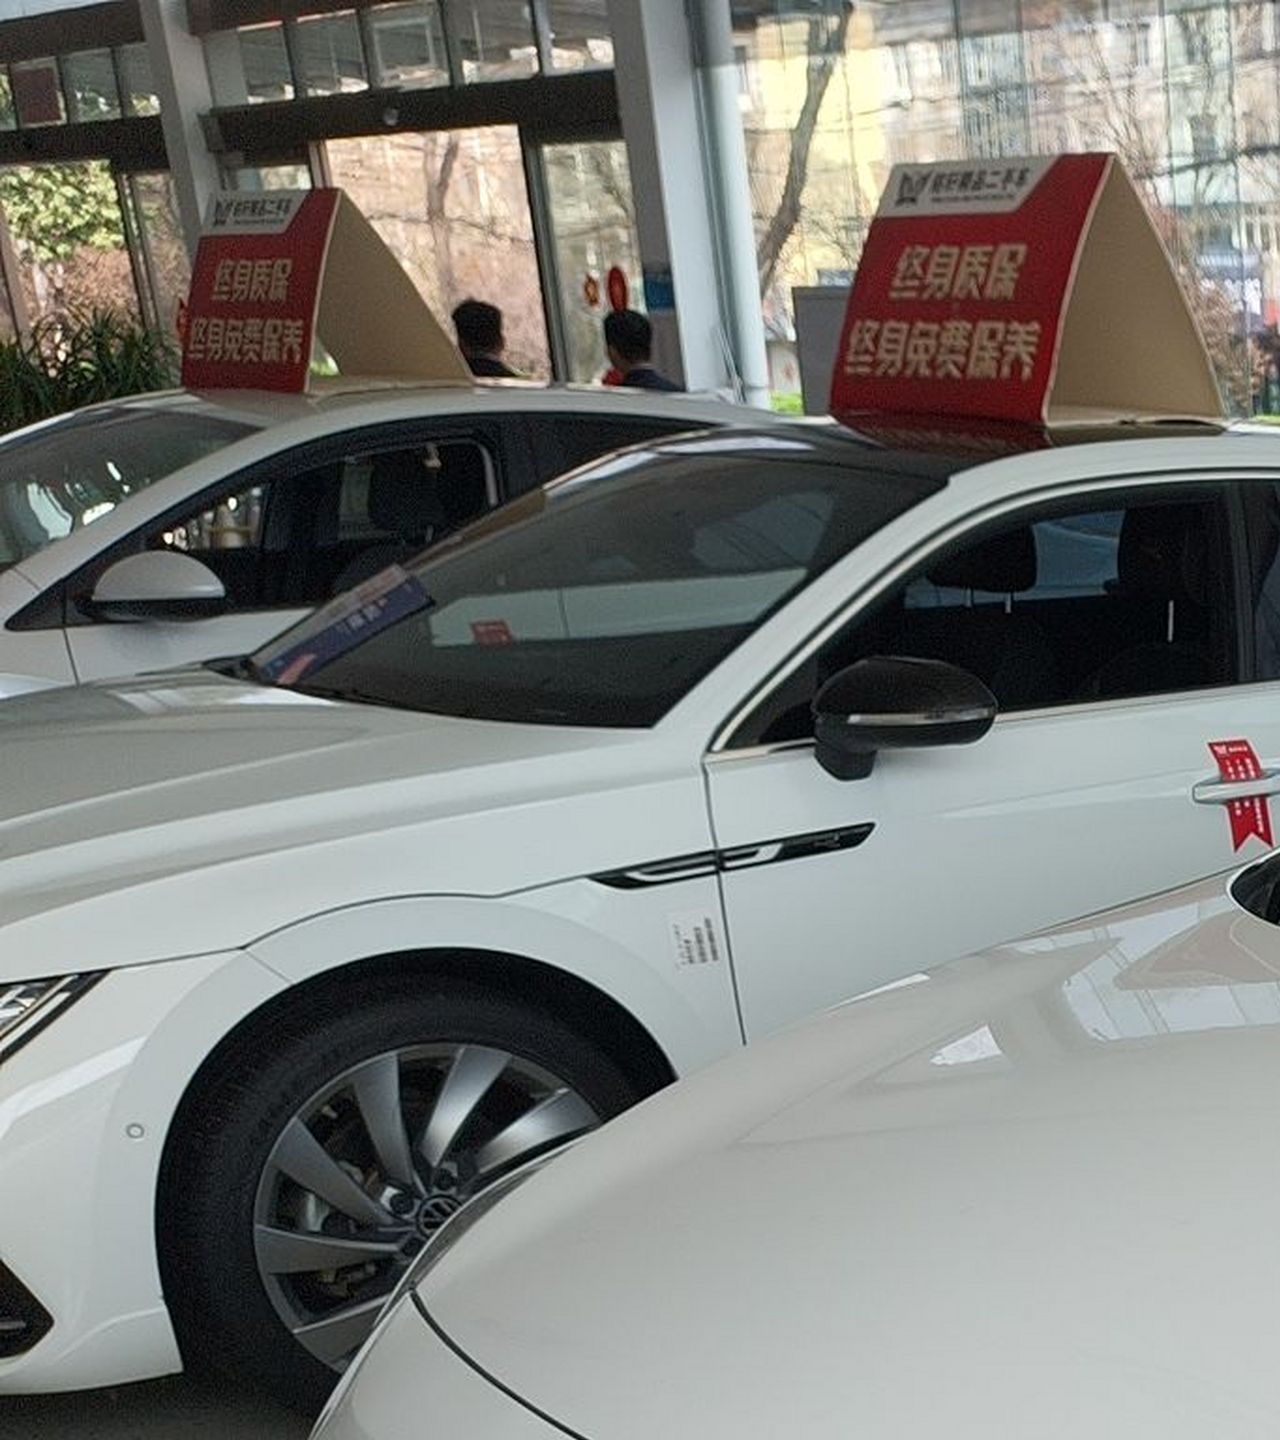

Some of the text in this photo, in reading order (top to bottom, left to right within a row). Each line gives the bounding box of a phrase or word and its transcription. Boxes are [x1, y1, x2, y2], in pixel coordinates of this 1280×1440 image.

[213, 258, 293, 302] 终身质保
[889, 244, 1027, 299] 终身质保
[190, 318, 303, 363] 终身免费保养
[844, 319, 1042, 381] 终身免费保养
